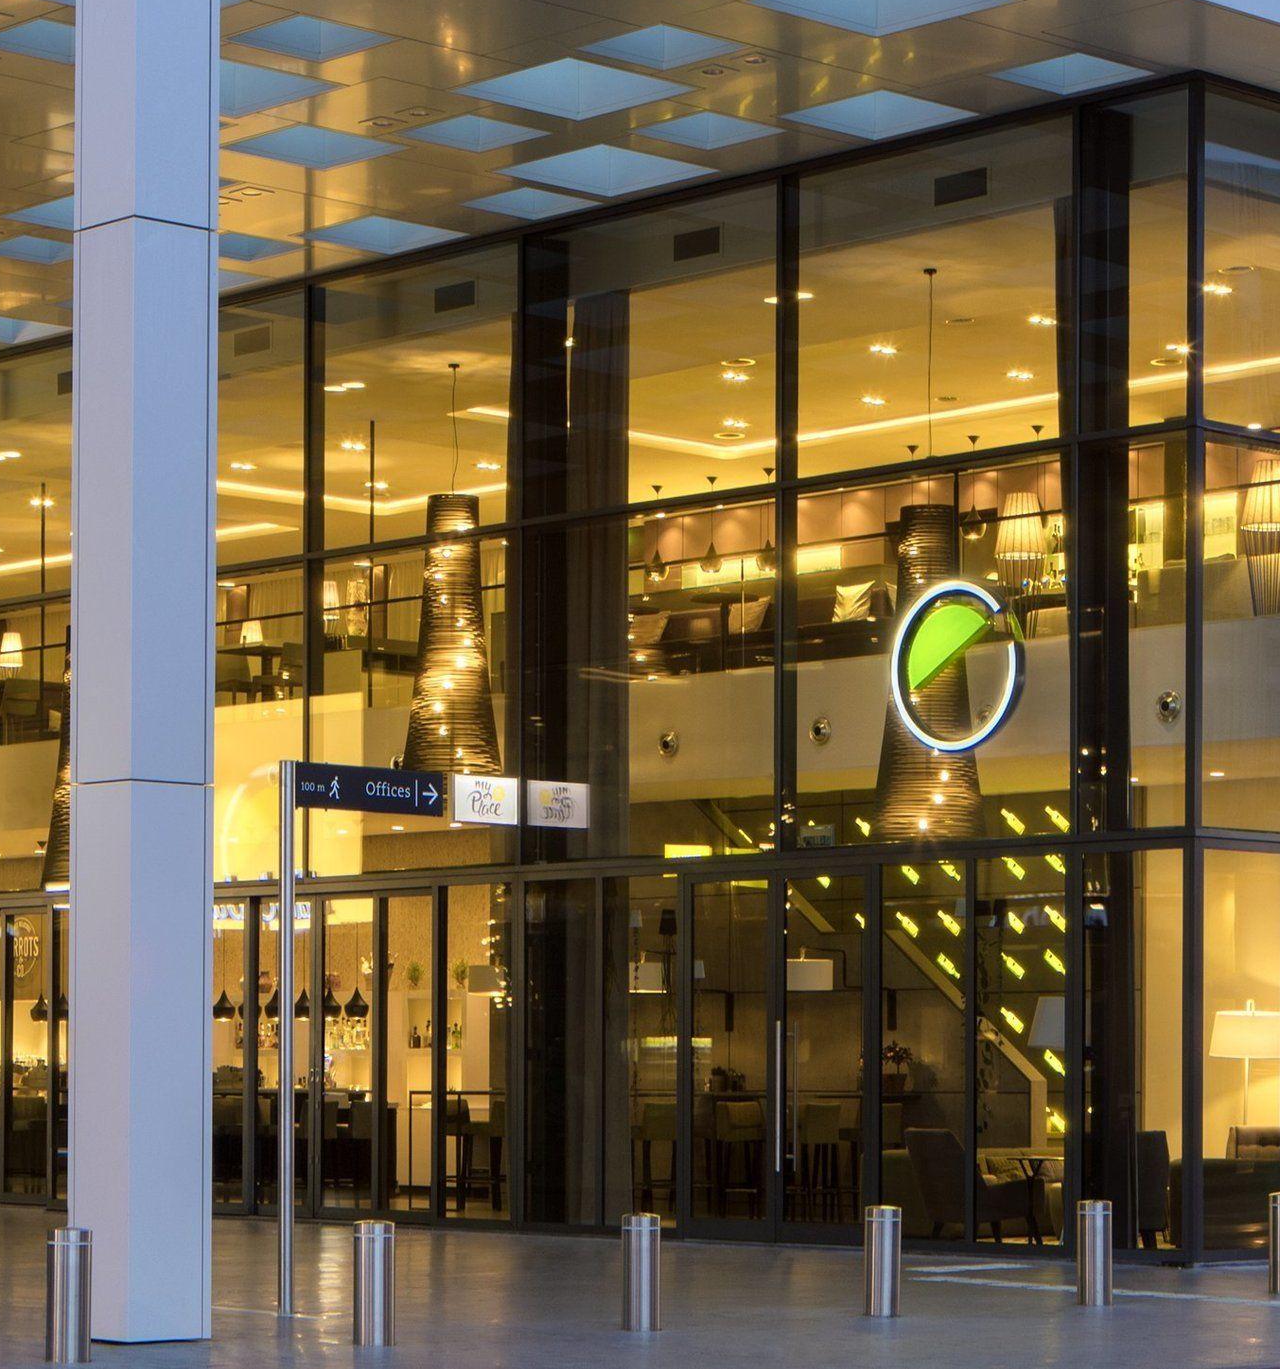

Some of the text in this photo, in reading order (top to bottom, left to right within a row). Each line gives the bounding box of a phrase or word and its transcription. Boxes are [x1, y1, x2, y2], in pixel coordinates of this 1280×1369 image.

[301, 781, 411, 798] 100 m Offices
[467, 790, 504, 817] Place
[14, 936, 39, 957] RROTS
